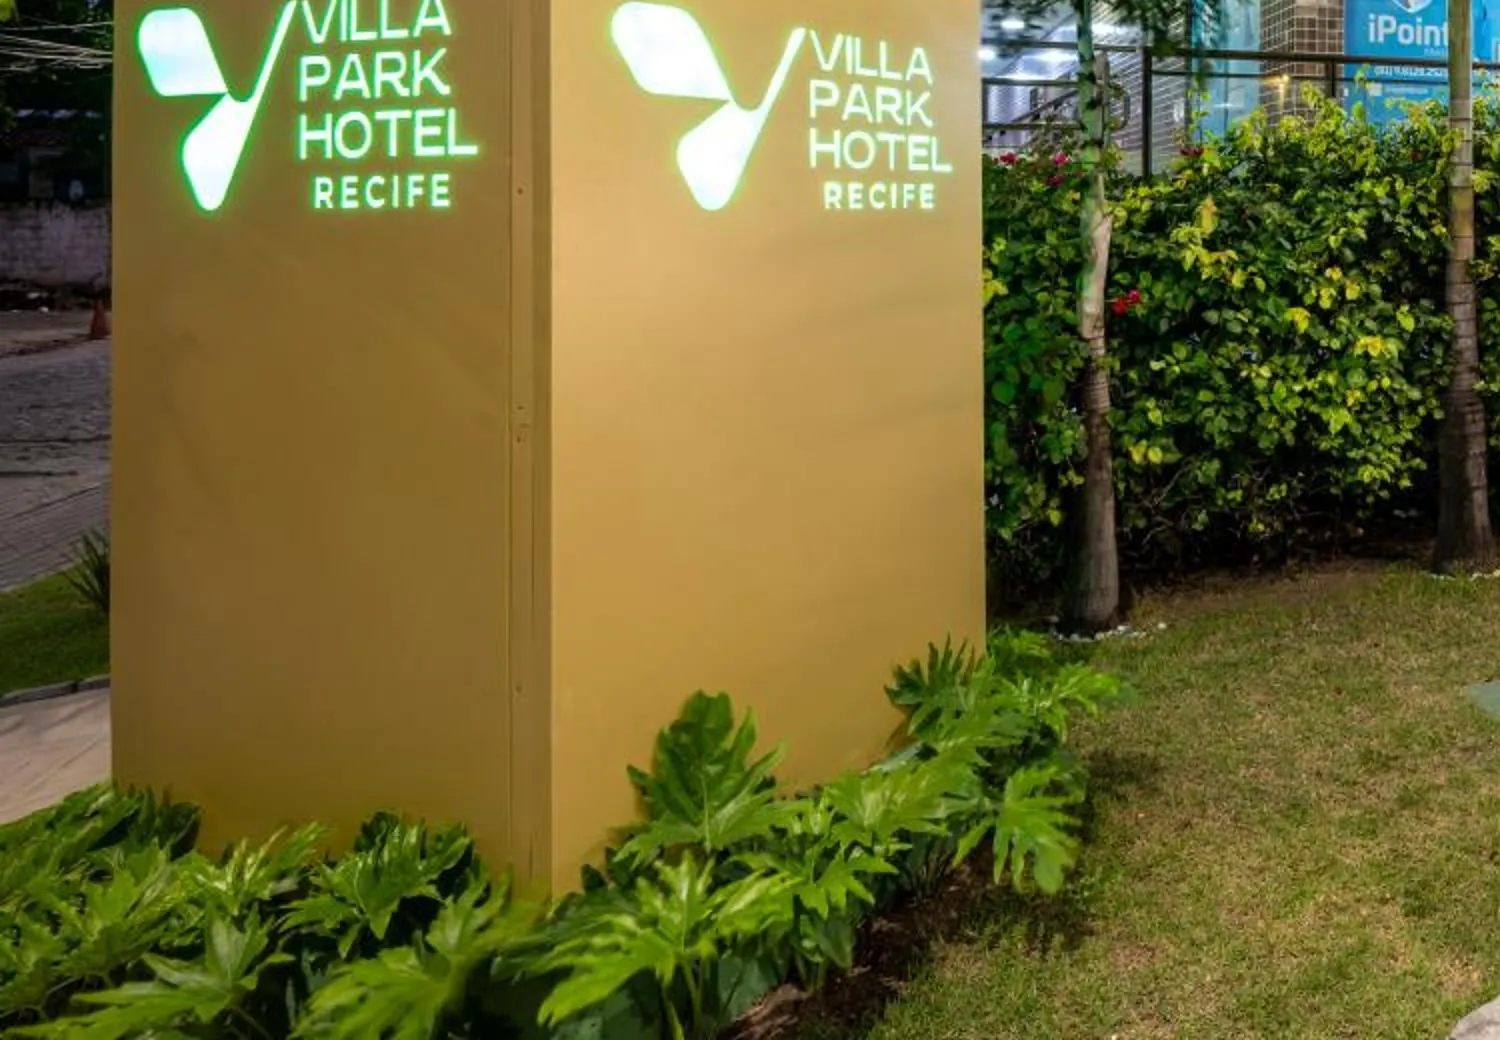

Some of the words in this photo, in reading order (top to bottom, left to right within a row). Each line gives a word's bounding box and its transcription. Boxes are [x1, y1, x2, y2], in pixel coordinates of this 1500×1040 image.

[300, 47, 451, 102] PARK
[809, 29, 933, 86] VILLA
[809, 79, 933, 128] PARK
[300, 107, 478, 160] HOTEL
[809, 127, 953, 172] HOTEL
[314, 173, 451, 209] RECIFE
[823, 180, 935, 209] RECIFE
